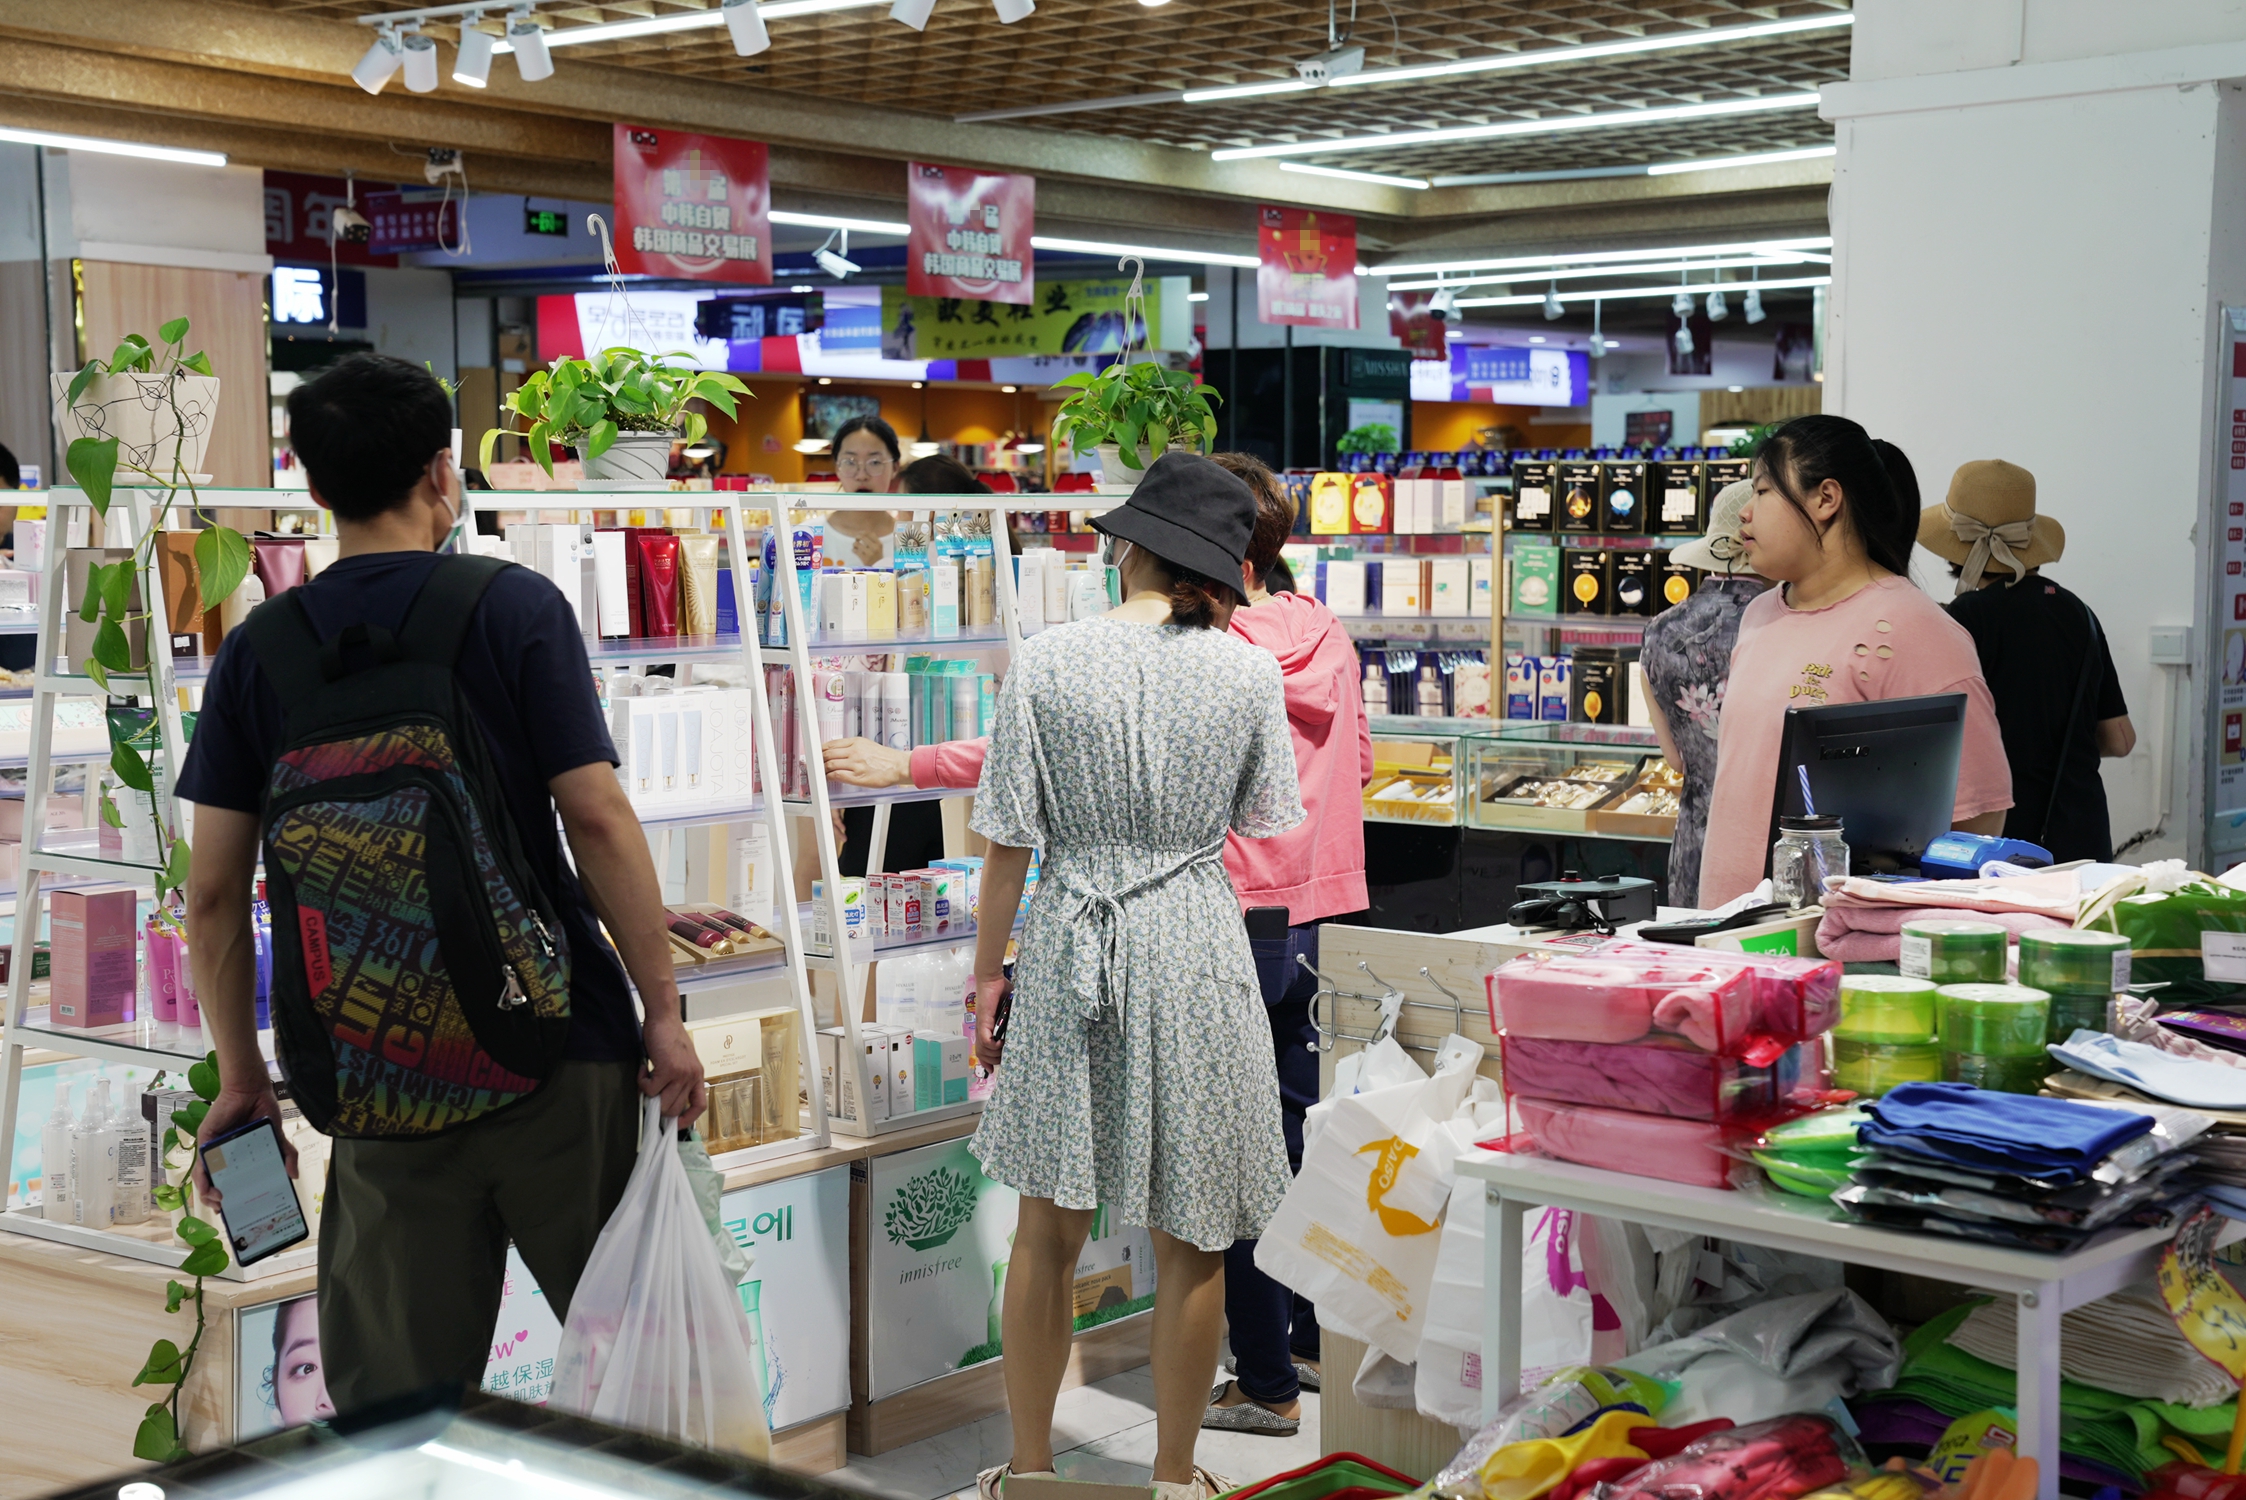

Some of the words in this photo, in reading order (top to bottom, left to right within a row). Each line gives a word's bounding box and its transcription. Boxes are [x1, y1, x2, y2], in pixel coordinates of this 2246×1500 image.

[662, 168, 728, 201] 第届
[661, 202, 732, 231] 中韩自贸
[632, 226, 759, 261] 韩国商品交易展
[709, 700, 724, 797] JOAJOTA
[733, 698, 748, 794] JOAJOTA
[305, 916, 326, 982] CAMPUS
[1378, 1137, 1405, 1189] DAISO
[898, 1255, 963, 1285] innisfree
[1101, 1274, 1112, 1283] pack
